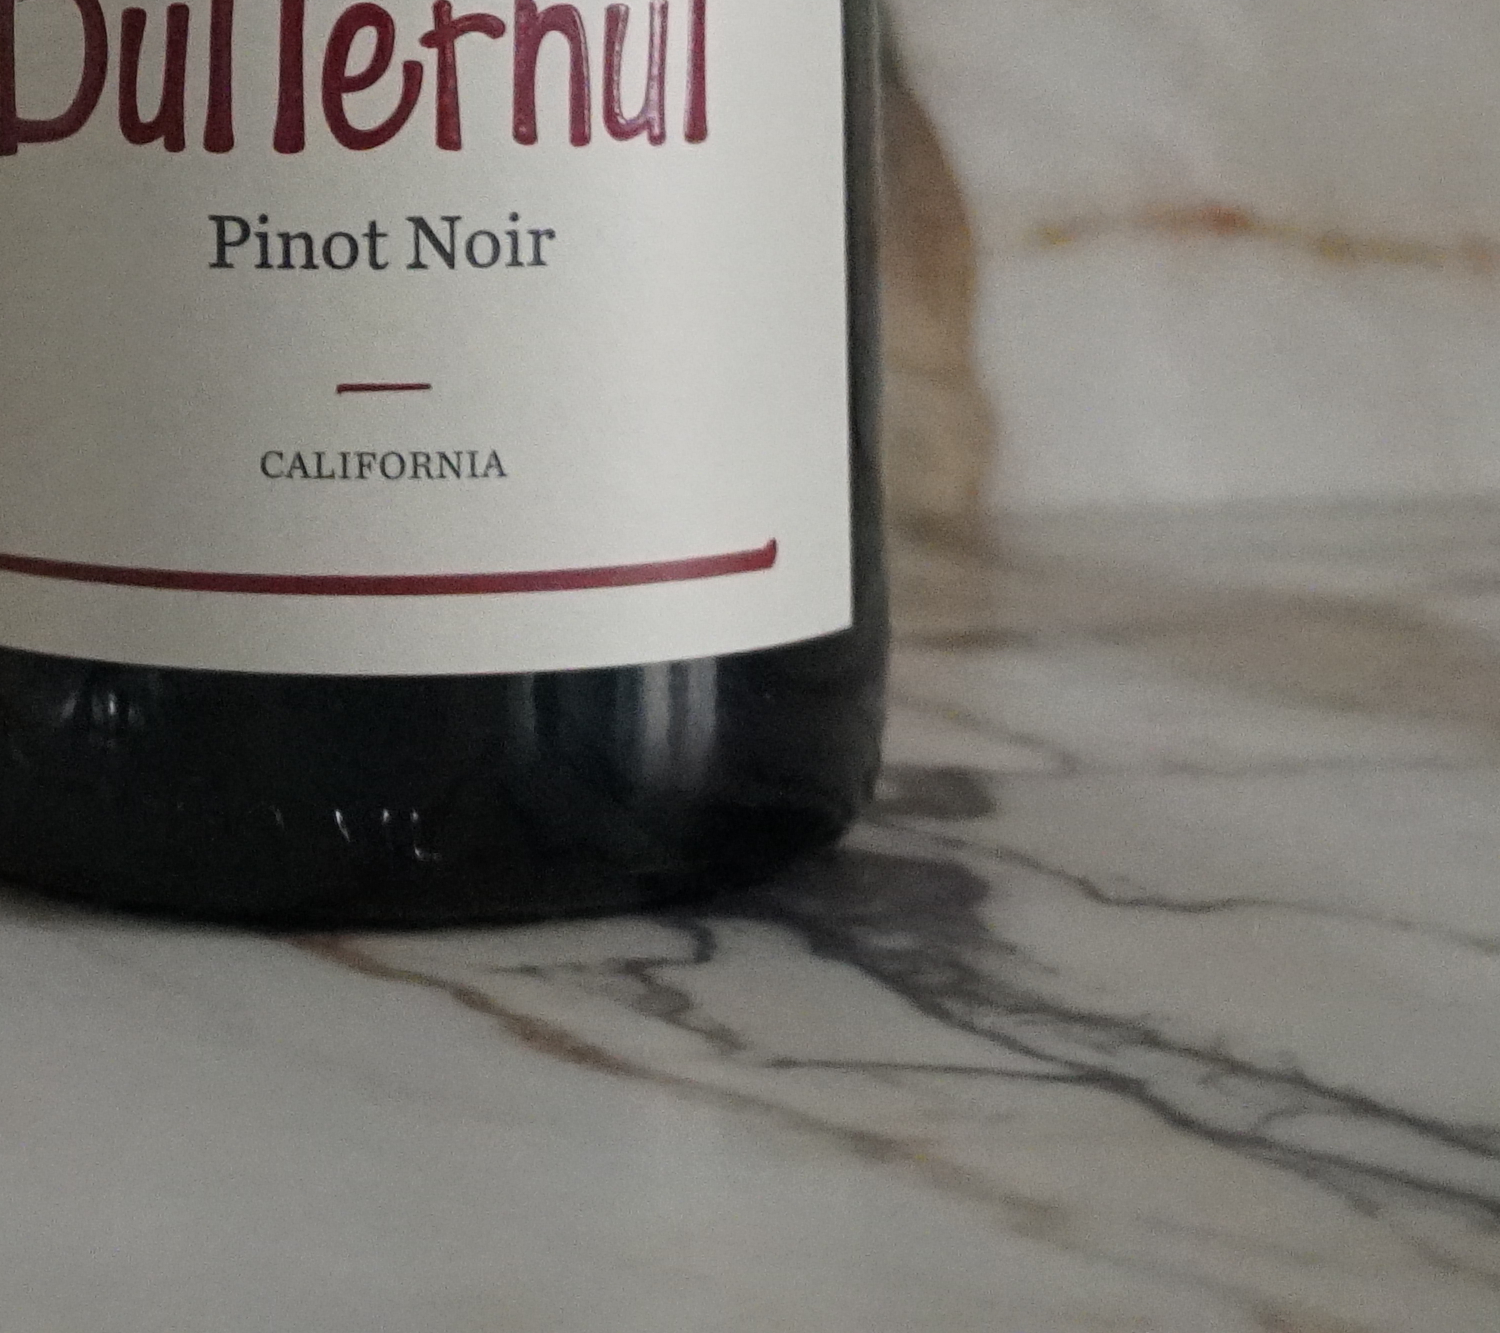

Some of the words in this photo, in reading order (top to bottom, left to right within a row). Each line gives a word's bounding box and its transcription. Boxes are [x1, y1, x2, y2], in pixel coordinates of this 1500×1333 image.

[207, 213, 390, 271] Pinot
[405, 212, 557, 271] Noir
[260, 449, 508, 481] CALIFORNIA
